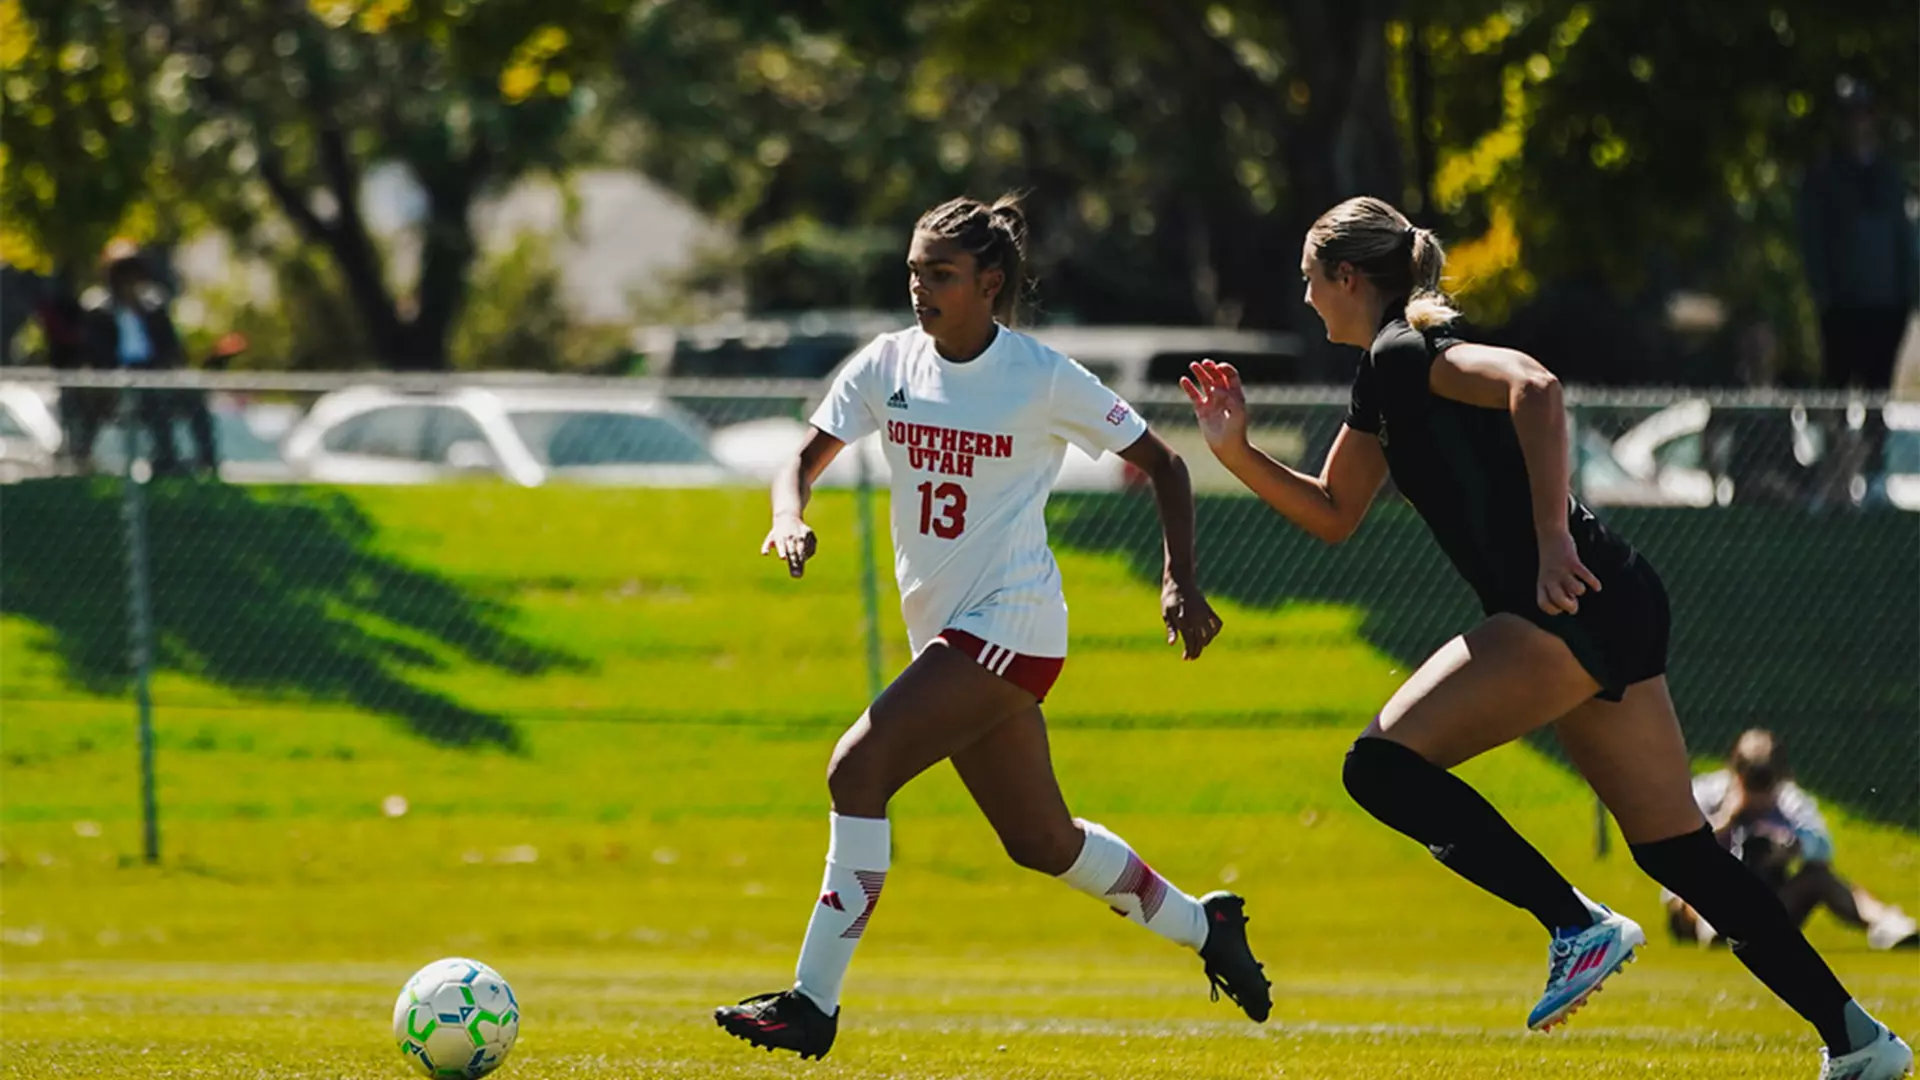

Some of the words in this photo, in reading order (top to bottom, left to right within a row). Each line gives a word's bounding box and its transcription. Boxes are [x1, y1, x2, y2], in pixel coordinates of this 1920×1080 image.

[887, 420, 1014, 458] SOUTHERN
[907, 447, 975, 478] UTAH
[917, 481, 968, 540] 13
